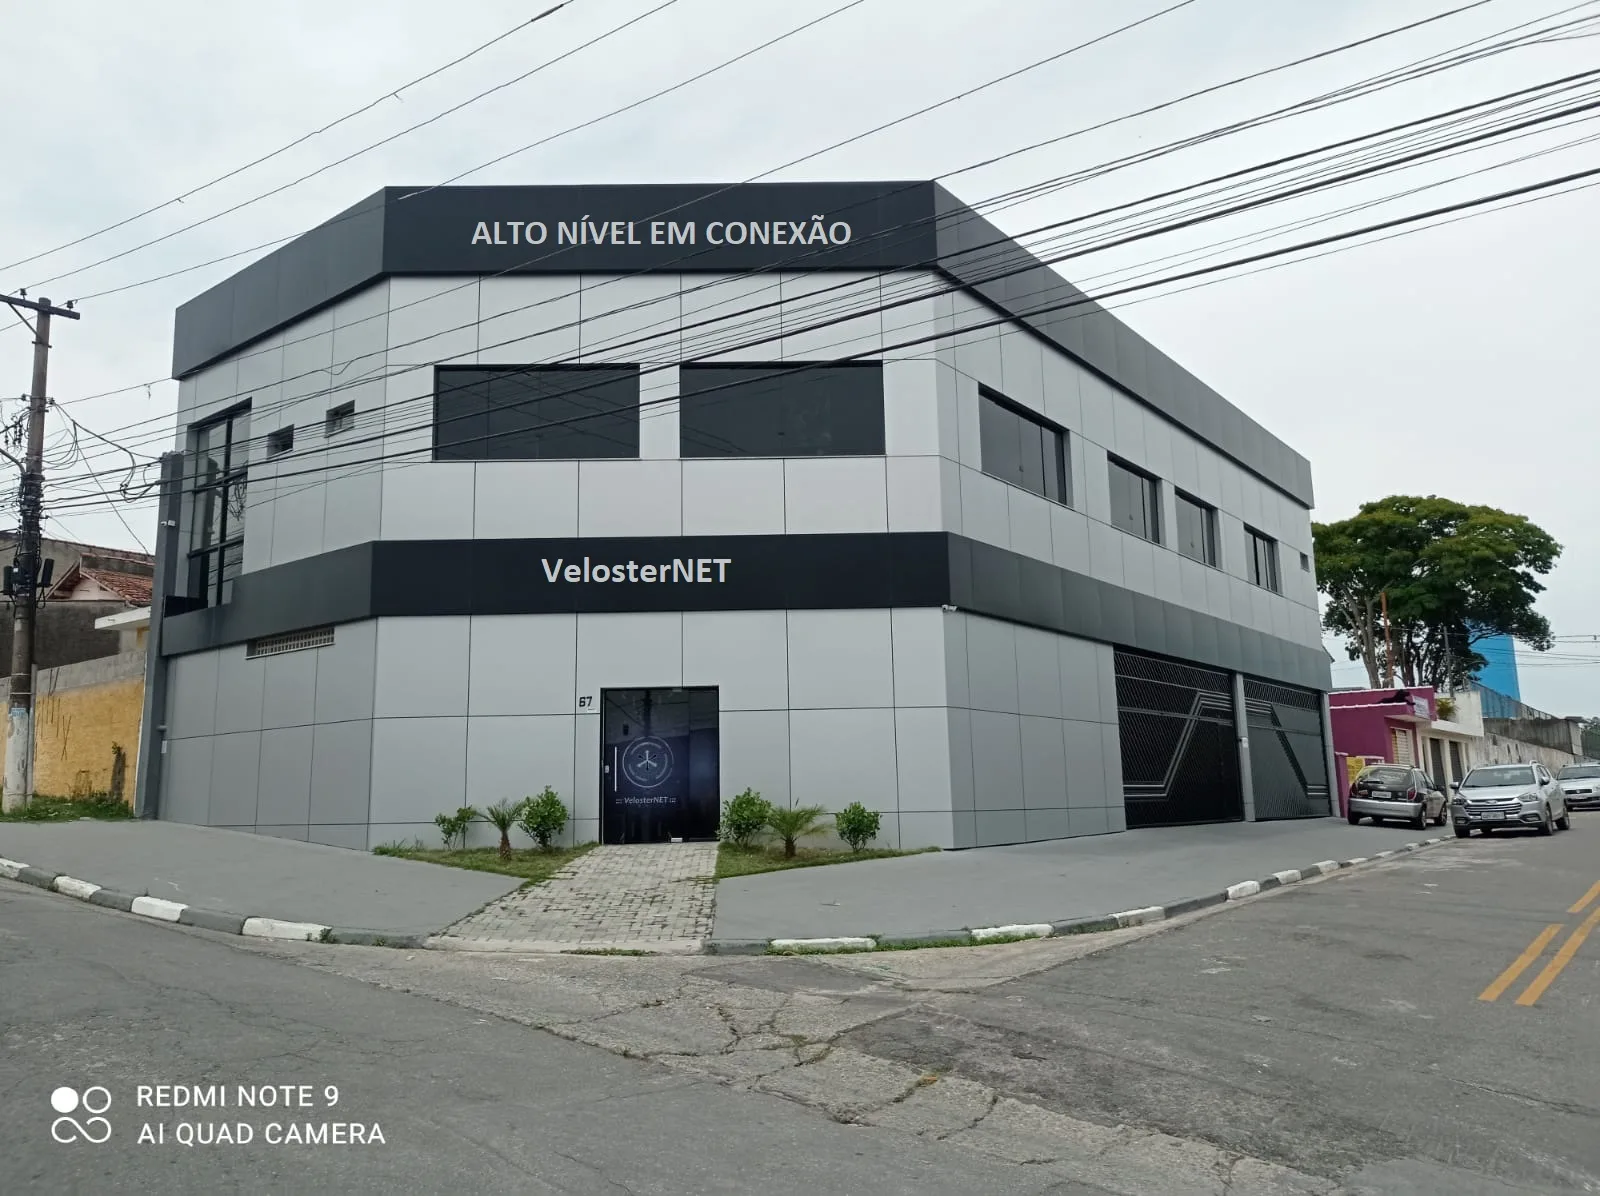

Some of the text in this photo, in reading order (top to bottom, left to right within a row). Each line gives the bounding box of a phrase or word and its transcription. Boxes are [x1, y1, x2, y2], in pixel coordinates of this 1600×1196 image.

[471, 214, 852, 245] ALTO NÍVEL EM CONEXÃO
[541, 556, 732, 583] VelosterNET
[578, 695, 593, 708] 67
